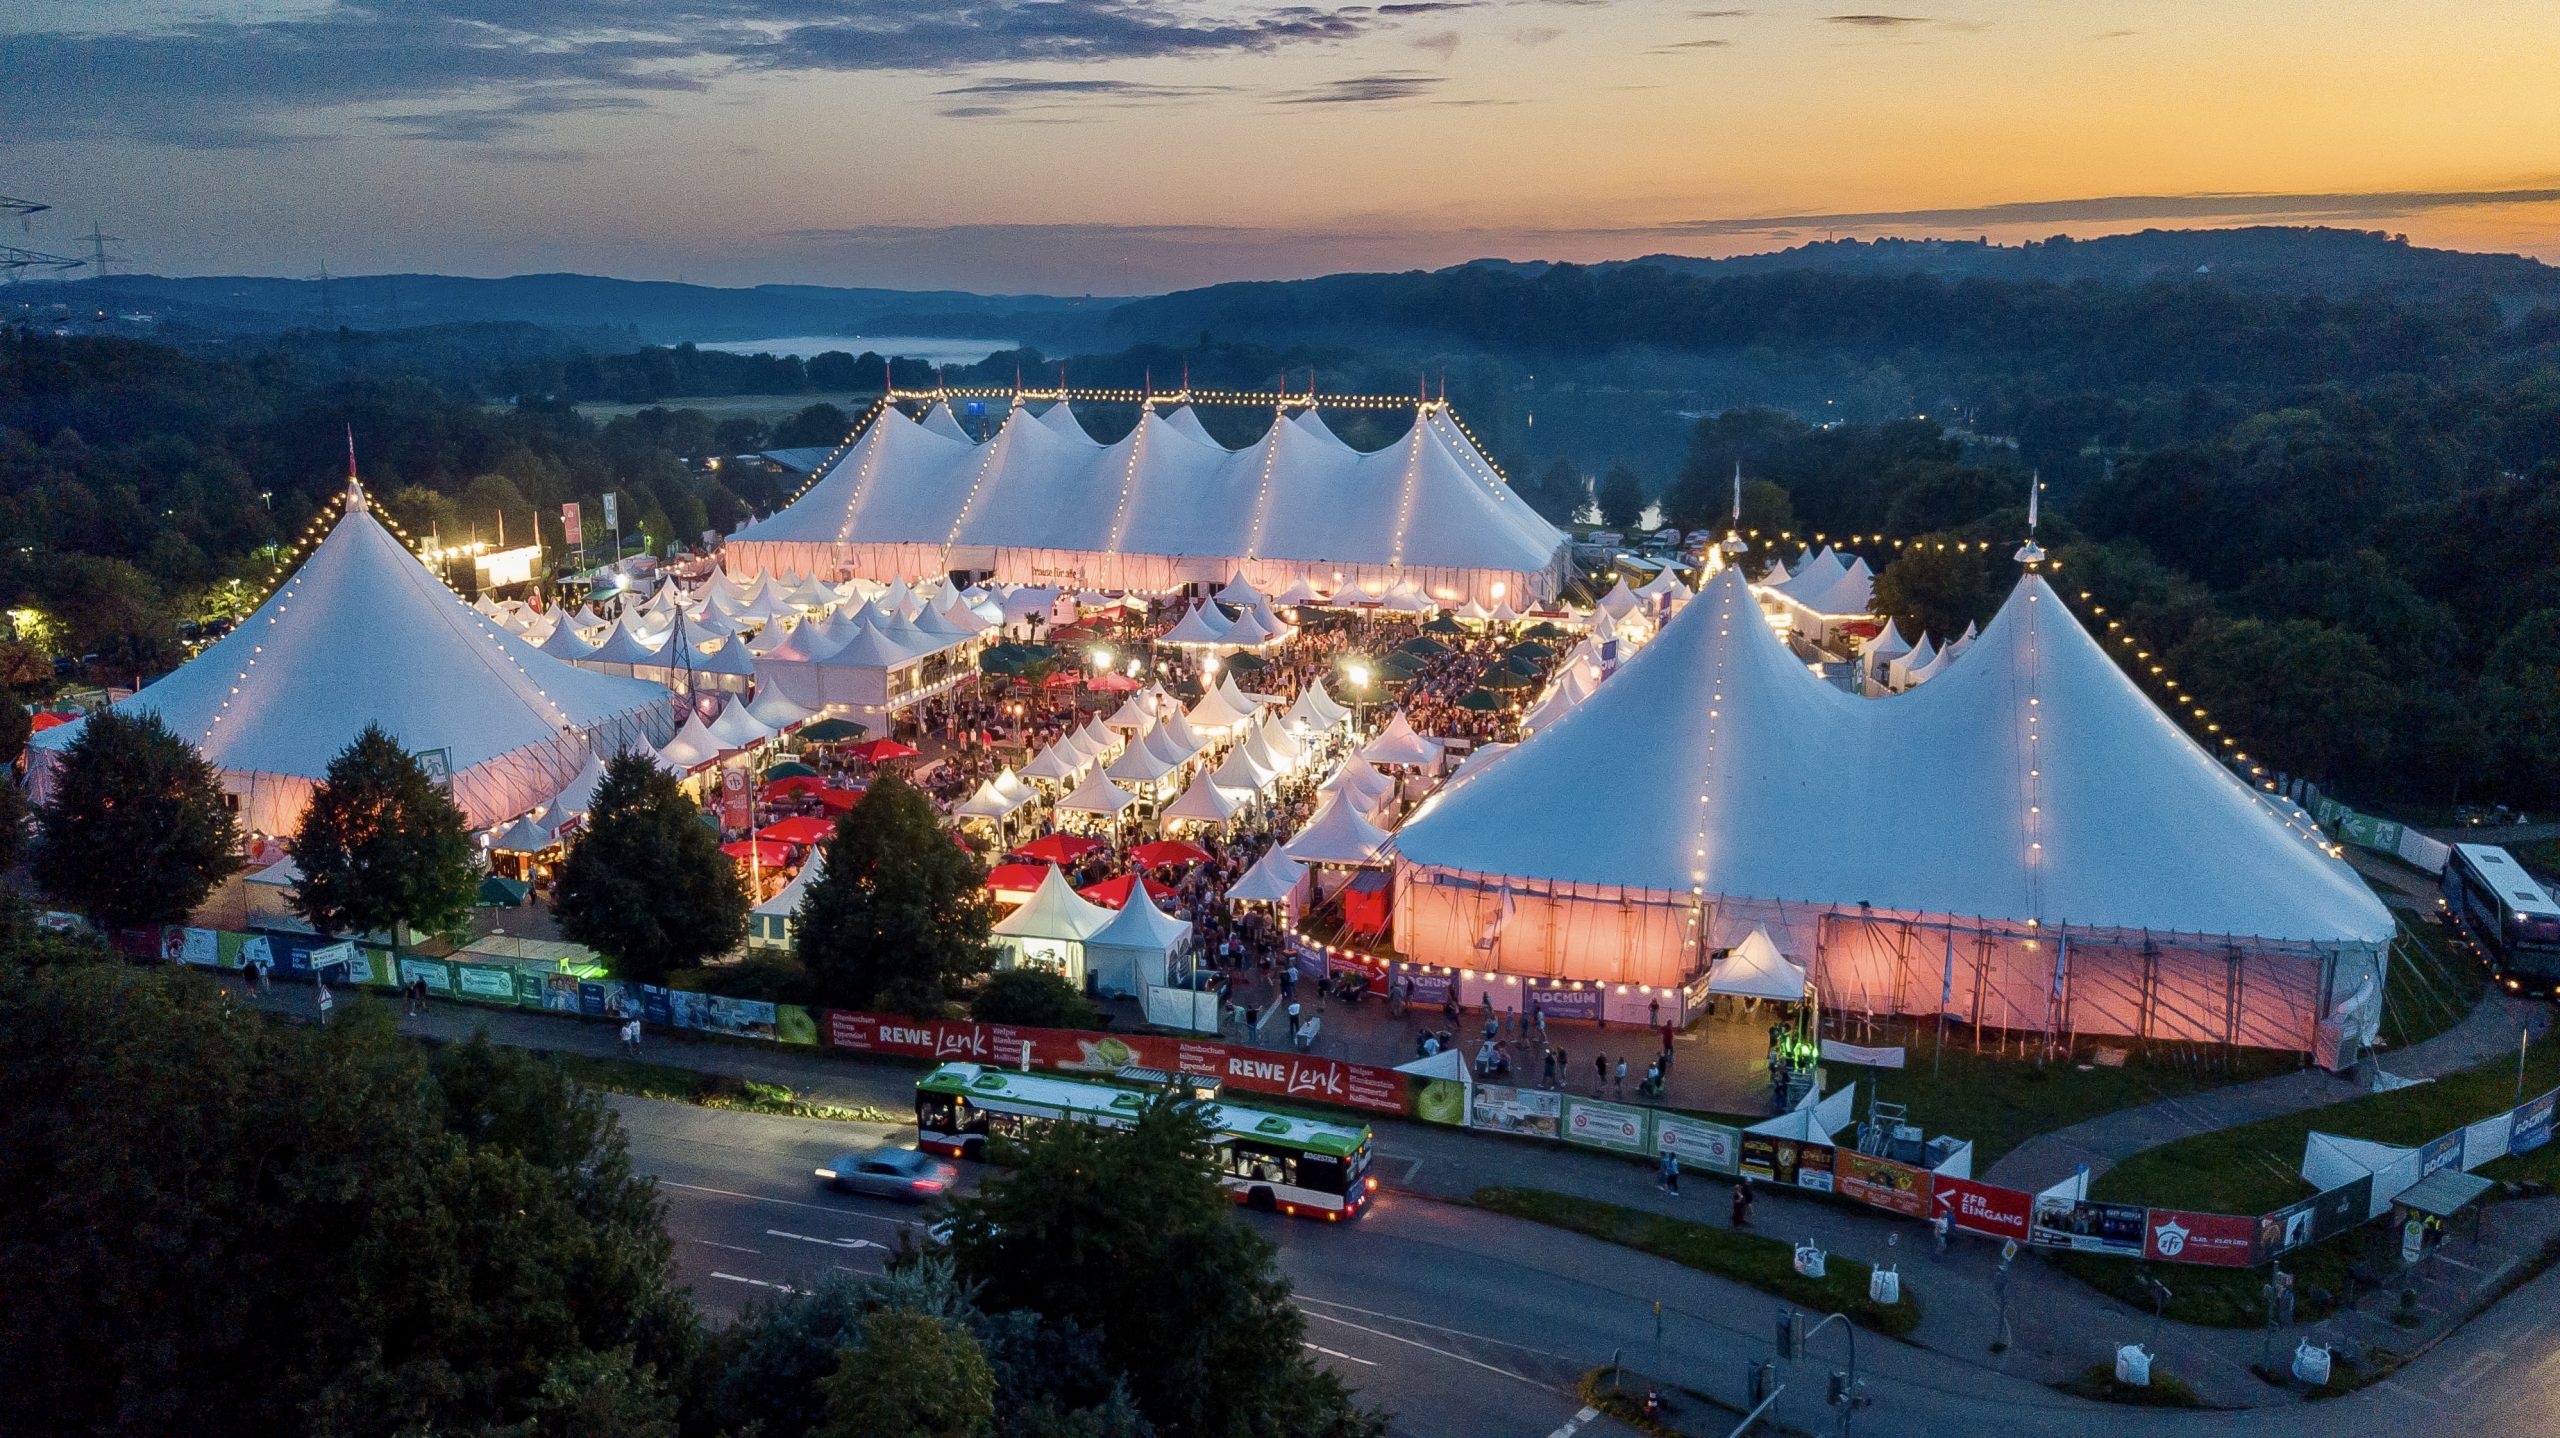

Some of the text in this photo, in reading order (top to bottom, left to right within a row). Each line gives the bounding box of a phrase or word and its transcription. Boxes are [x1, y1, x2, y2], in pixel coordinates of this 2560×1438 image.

[1532, 992, 1596, 1004] BOCHUM
[879, 1025, 988, 1057] REWE Lenk
[1179, 1060, 1216, 1074] Eppendorf
[1228, 1058, 1343, 1095] REWE Lenk
[1961, 1192, 1988, 1208] ZFR
[1961, 1203, 2023, 1226] EINGANG
[2160, 1235, 2181, 1253] zfr
